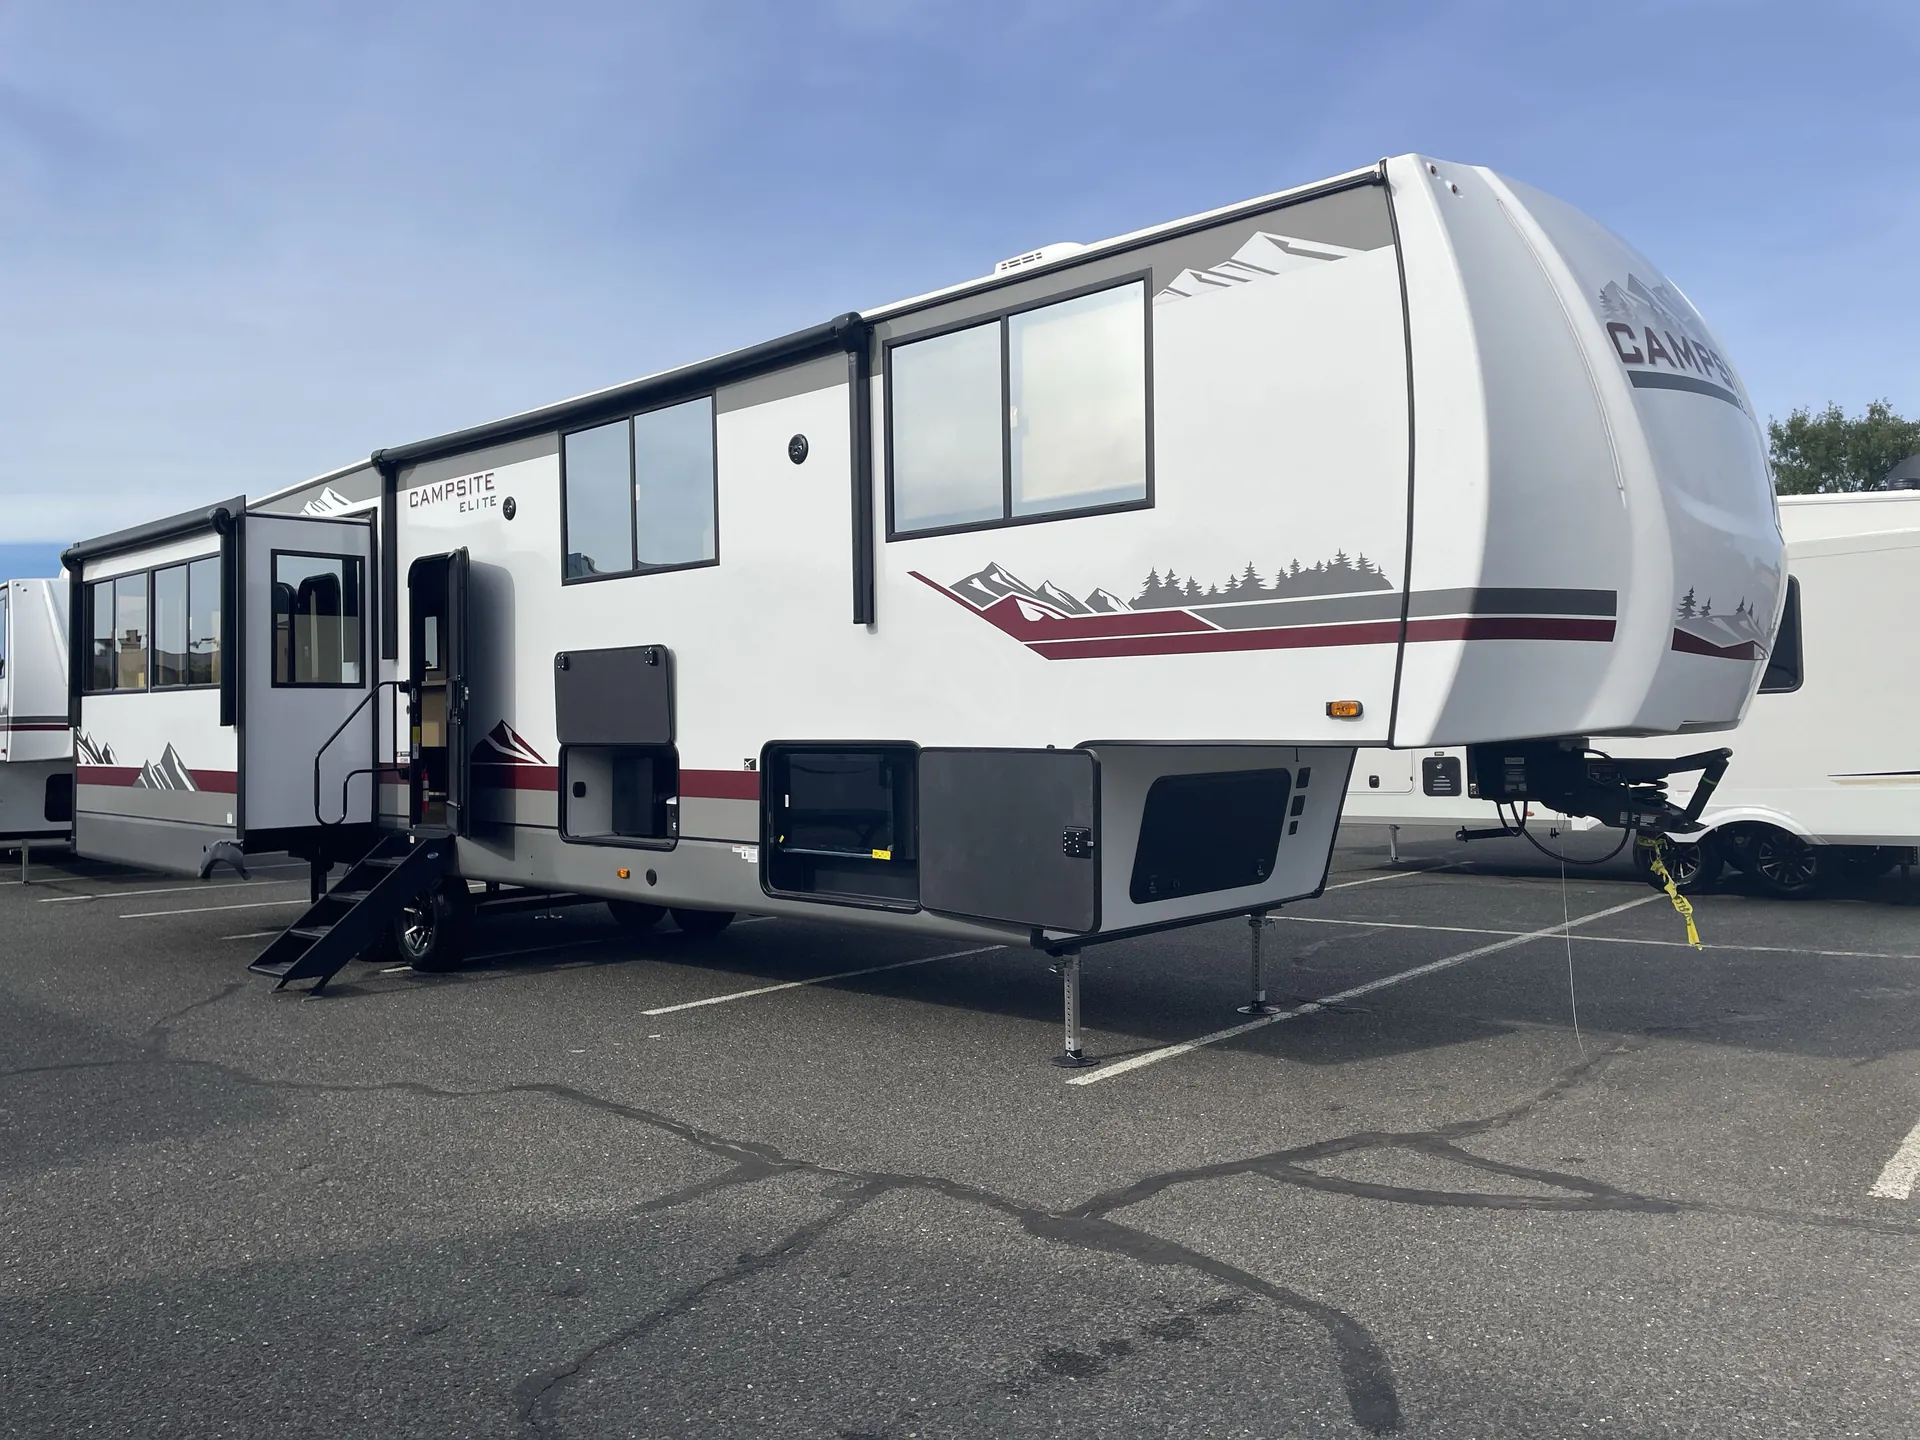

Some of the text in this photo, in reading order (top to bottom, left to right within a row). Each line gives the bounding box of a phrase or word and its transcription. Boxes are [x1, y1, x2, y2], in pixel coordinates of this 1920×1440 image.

[1606, 321, 1738, 391] CAMPS
[409, 472, 495, 508] CAMPSITE
[459, 495, 497, 513] ELITE
